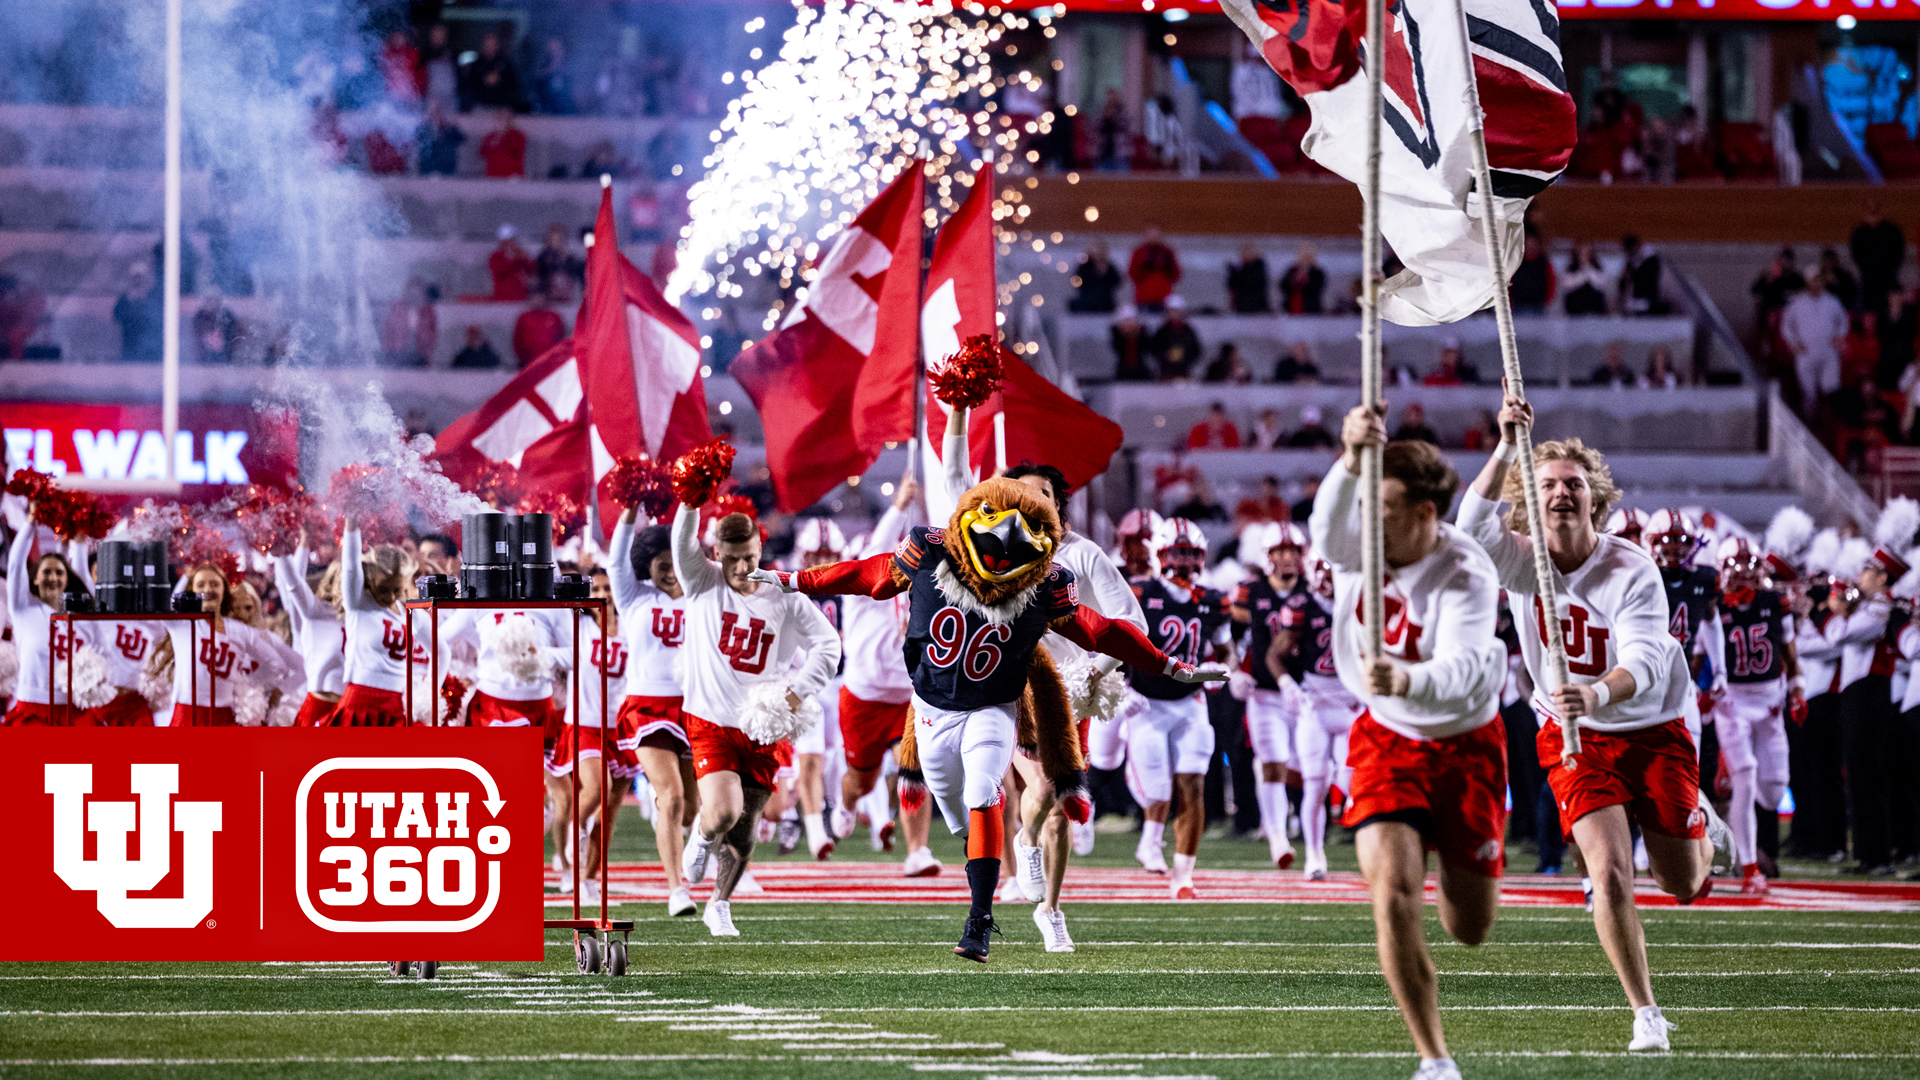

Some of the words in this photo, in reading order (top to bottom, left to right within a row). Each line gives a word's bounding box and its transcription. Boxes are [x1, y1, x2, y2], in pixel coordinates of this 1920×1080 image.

[72, 429, 249, 484] WALK
[926, 606, 1012, 682] 96
[1158, 614, 1202, 668] 21
[1728, 621, 1774, 677] 15
